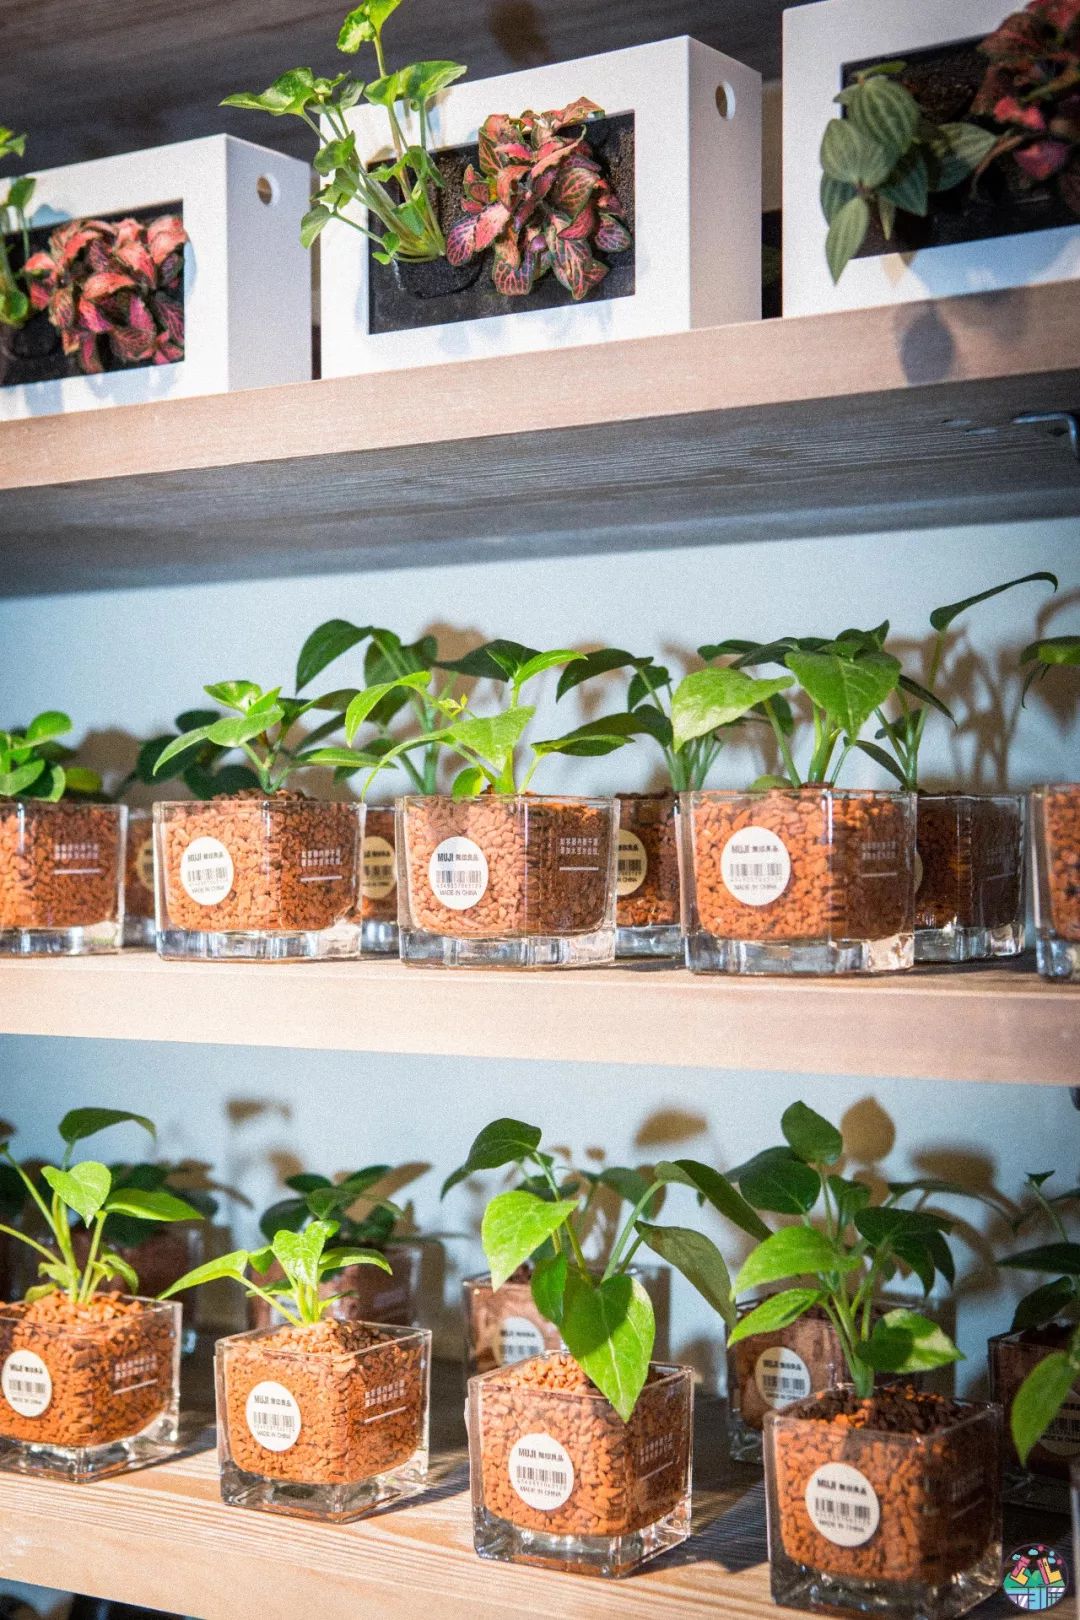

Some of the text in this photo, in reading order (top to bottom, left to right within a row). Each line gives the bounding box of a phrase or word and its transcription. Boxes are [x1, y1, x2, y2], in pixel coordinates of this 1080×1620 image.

[732, 845, 749, 854] MUJI
[438, 852, 454, 862] MUJI
[254, 1395, 269, 1404] MUJI
[518, 1448, 536, 1458] MUJI
[817, 1478, 836, 1490] MUJI
